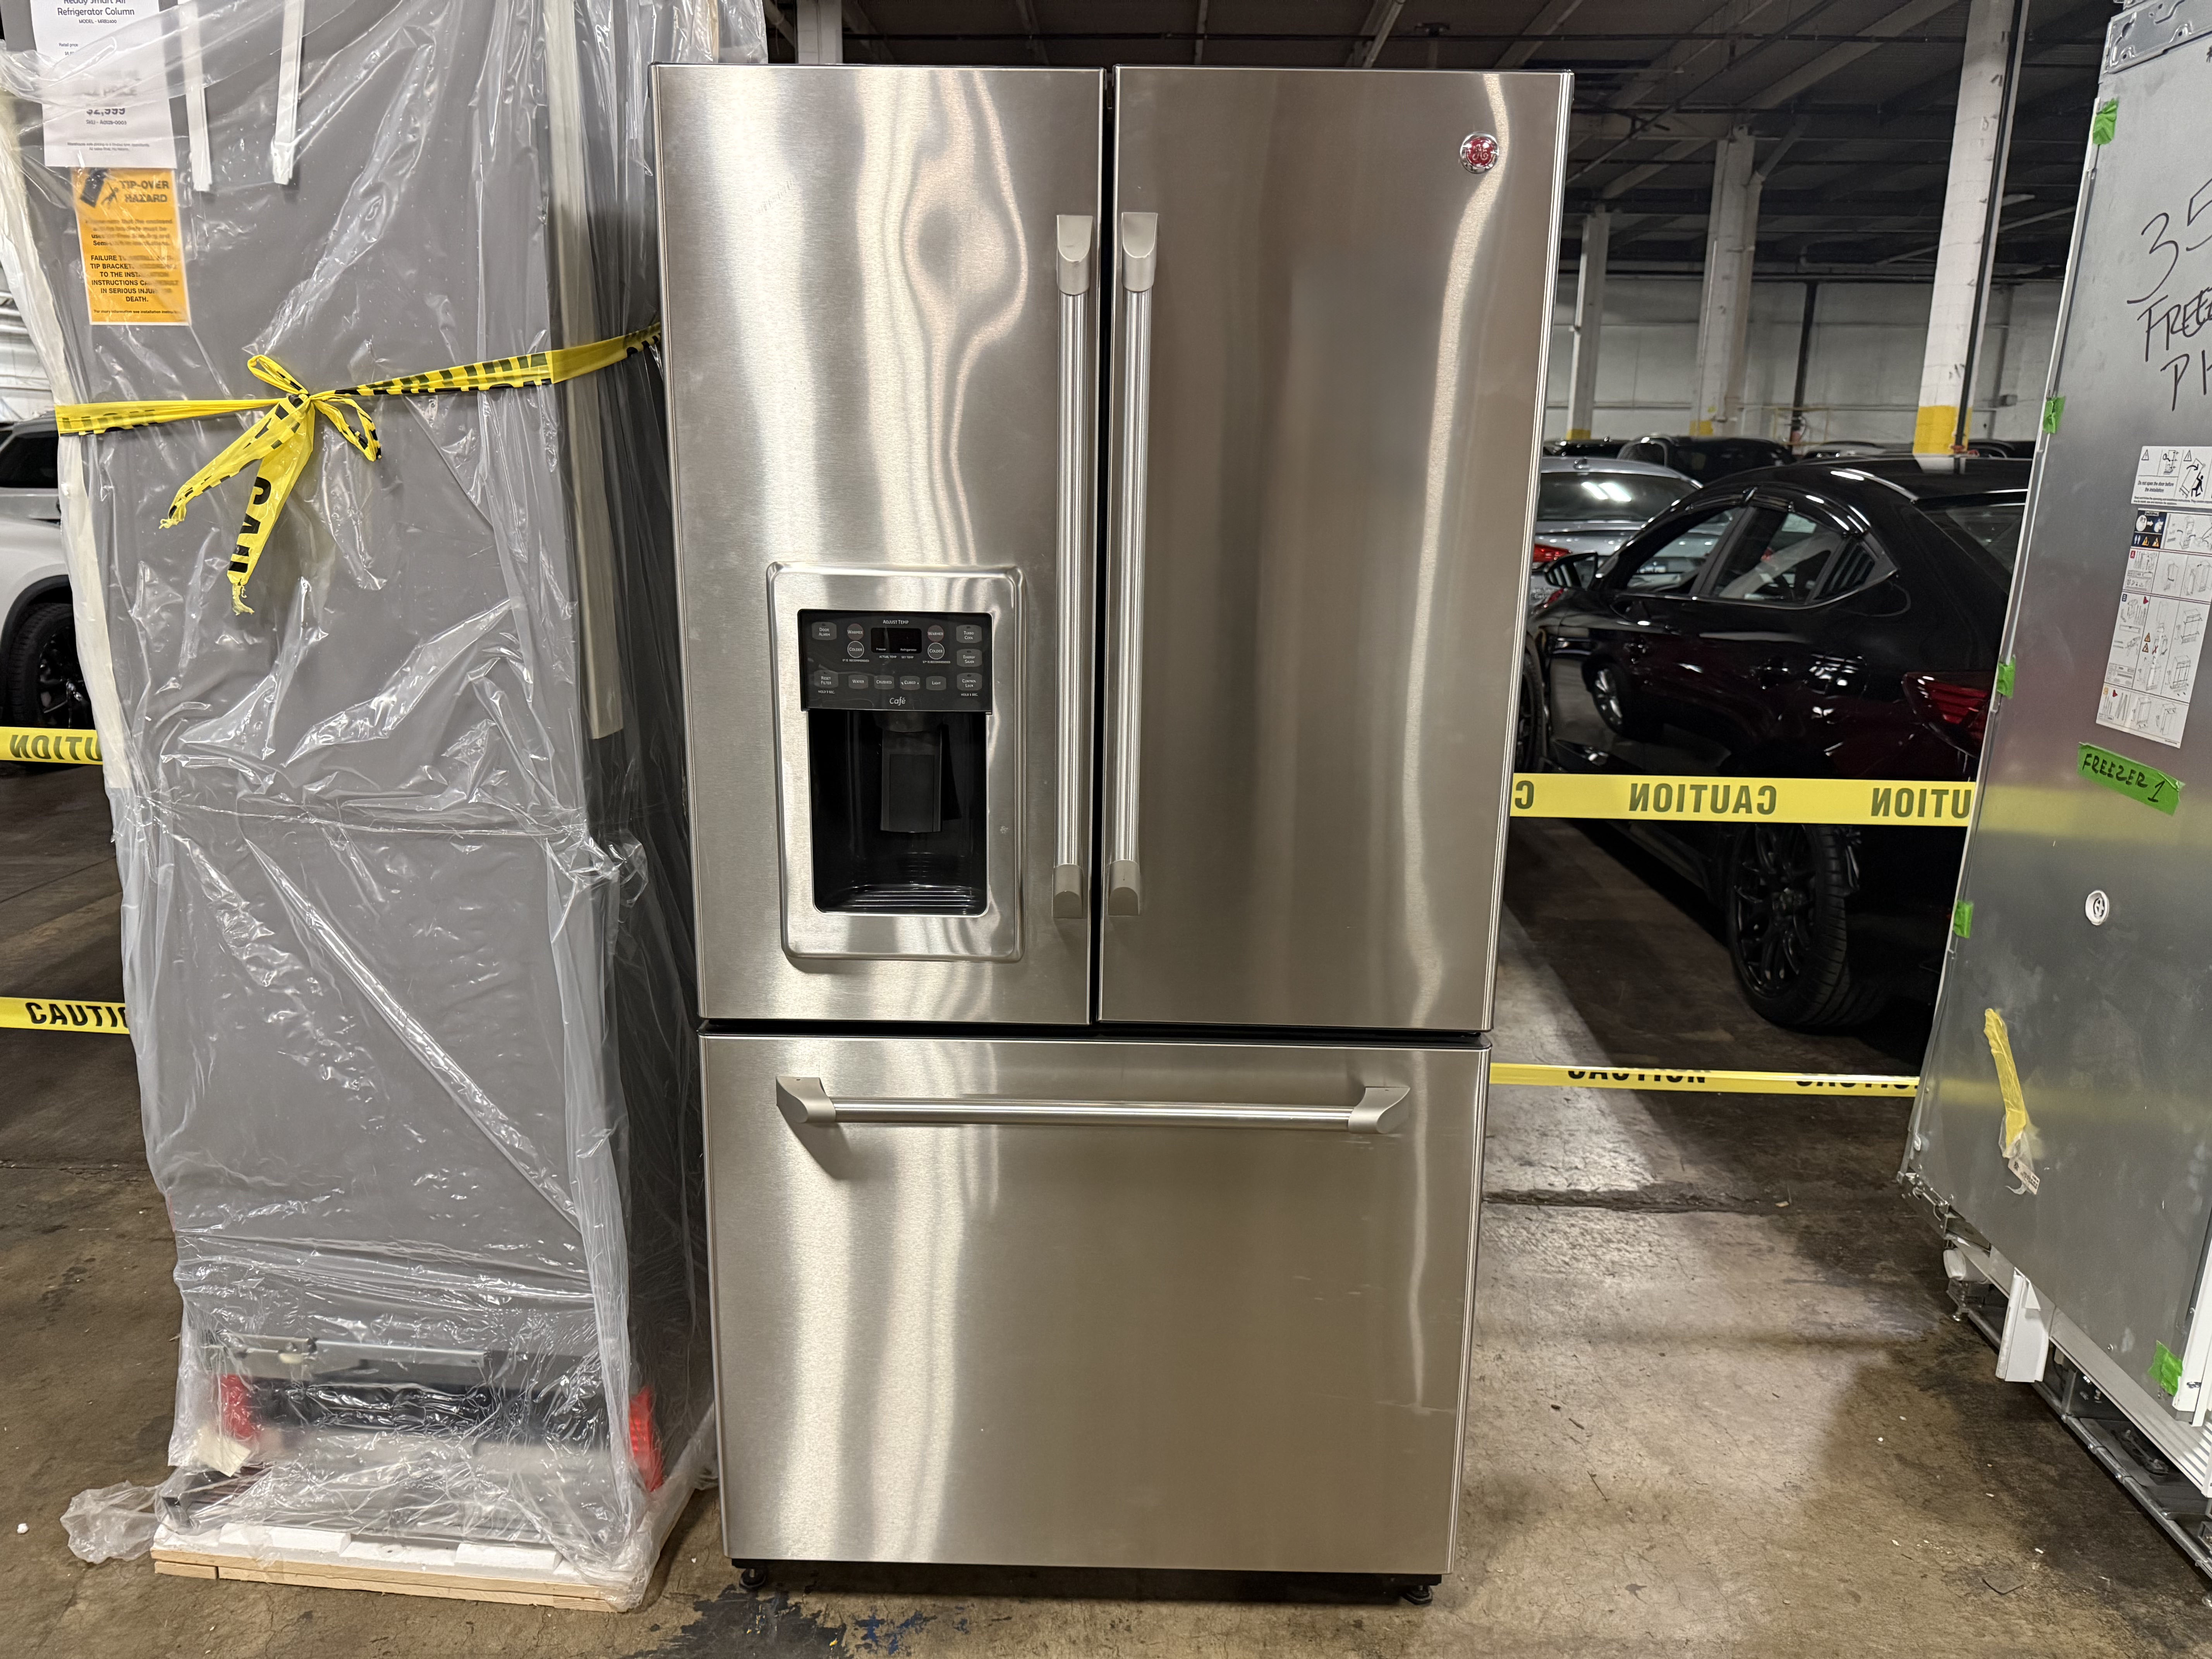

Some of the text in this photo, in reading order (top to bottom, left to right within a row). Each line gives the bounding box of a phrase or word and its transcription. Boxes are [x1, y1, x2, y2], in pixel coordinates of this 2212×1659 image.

[57, 7, 103, 16] Refrigerator
[119, 180, 169, 189] TIP-OVER
[124, 194, 167, 203] HAZARD
[890, 697, 906, 706] Café
[2082, 754, 2166, 802] FREEZER 1
[25, 1002, 129, 1028] CAUTI
